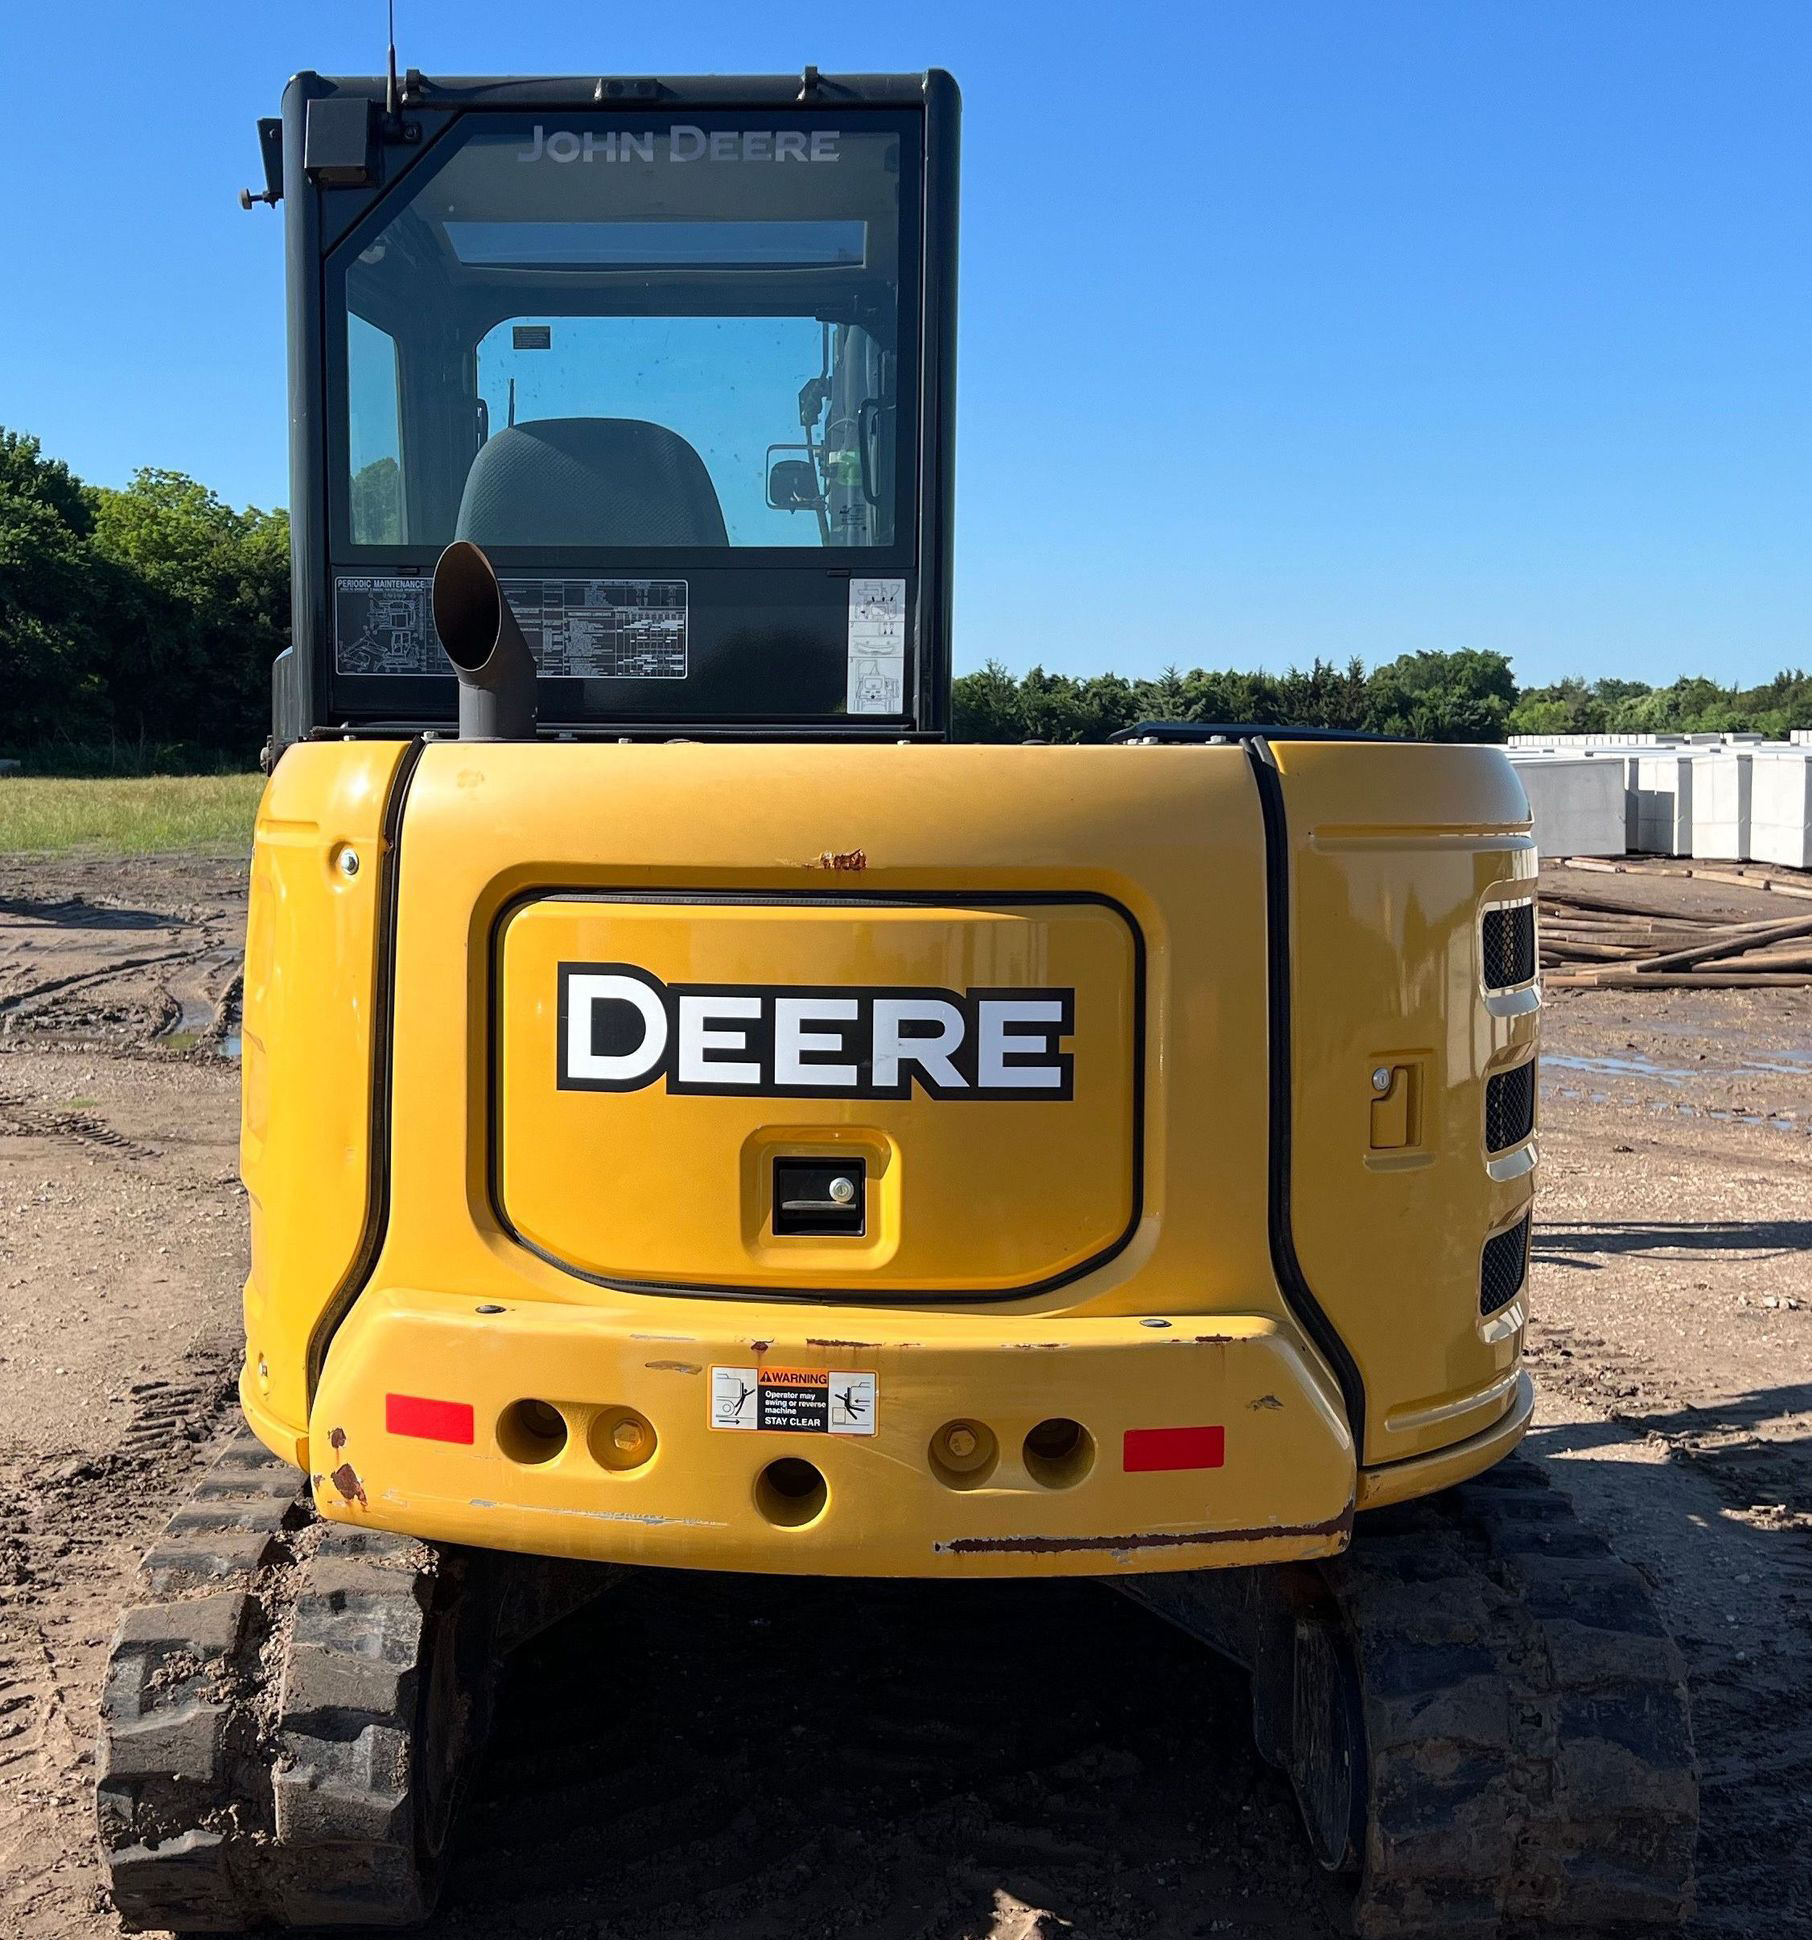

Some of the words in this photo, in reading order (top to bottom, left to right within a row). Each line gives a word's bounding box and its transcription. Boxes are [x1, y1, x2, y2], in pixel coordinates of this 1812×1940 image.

[518, 125, 654, 163] JOHN
[670, 125, 840, 163] DEERE
[338, 579, 371, 588] PERIODIC
[373, 580, 424, 588] MAINTENANCE
[567, 972, 1062, 1088] DEERE
[772, 1373, 827, 1384] WARNING
[765, 1390, 798, 1400] Operator
[799, 1393, 816, 1401] may
[765, 1399, 787, 1408] swing
[765, 1407, 797, 1415] machine
[765, 1417, 788, 1425] STAY
[790, 1418, 820, 1426] CLEAR
